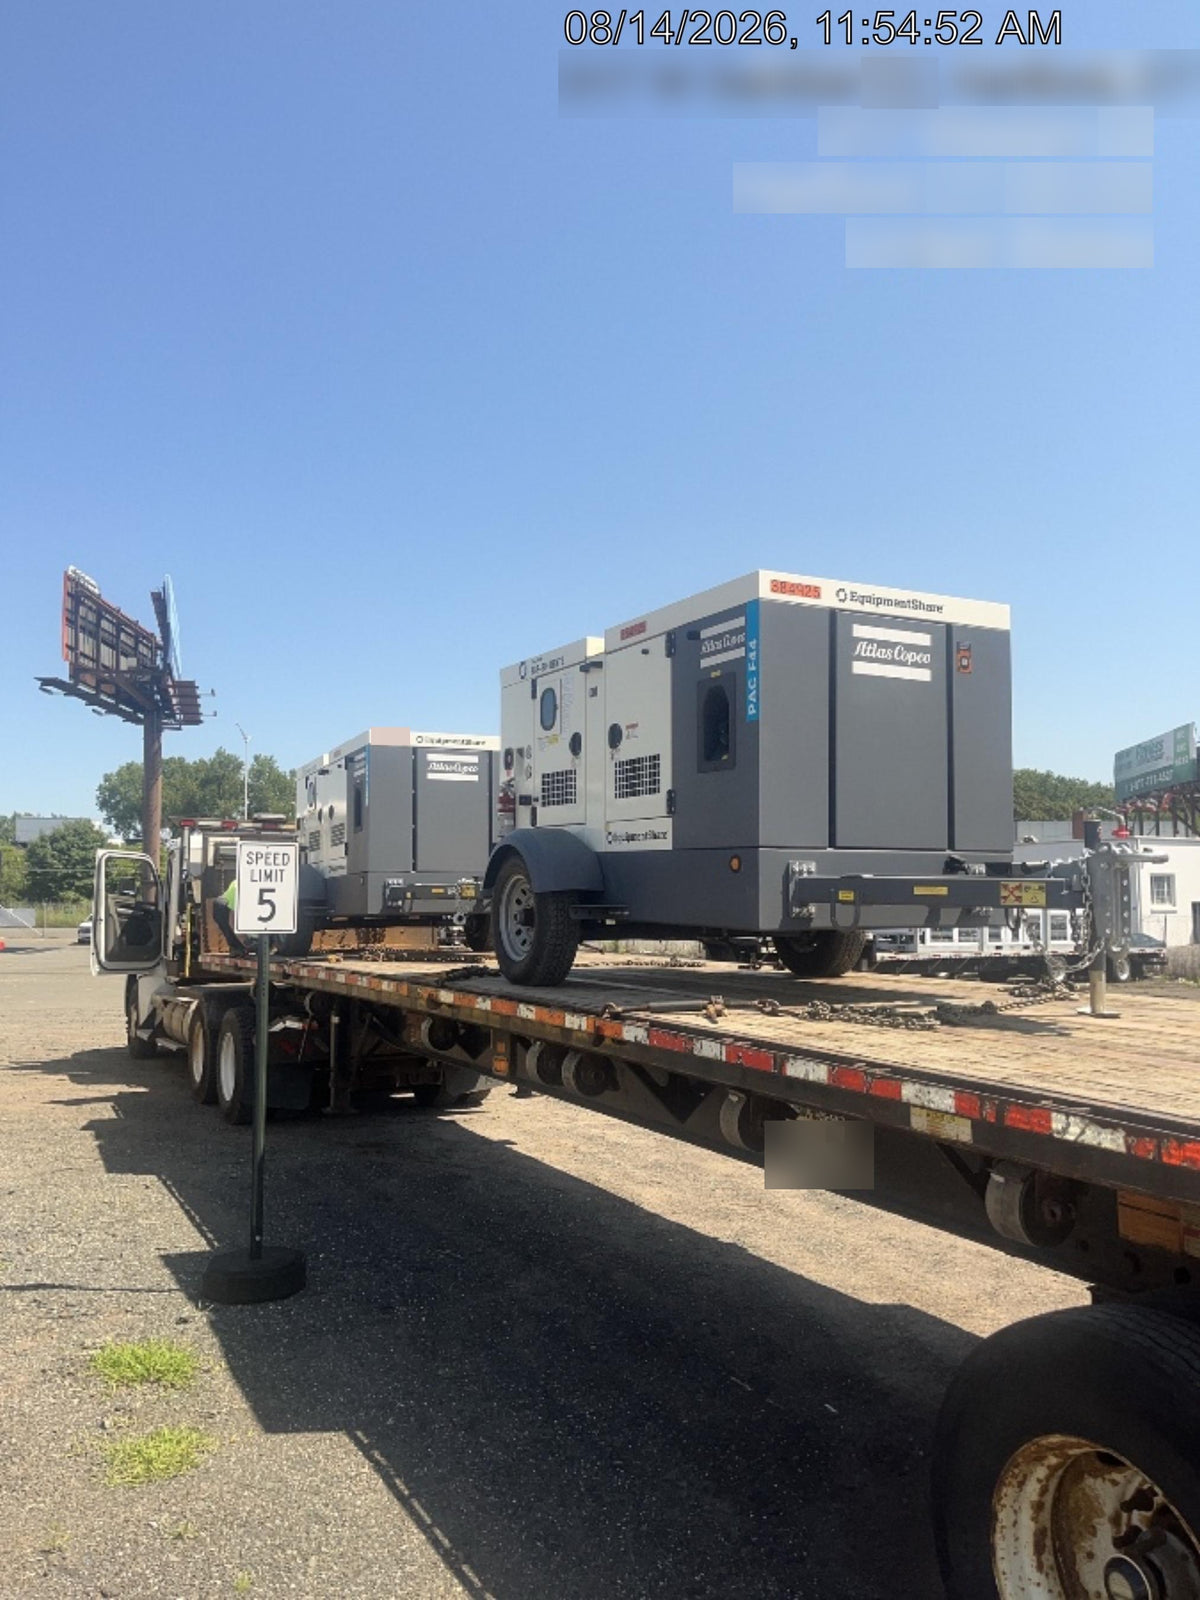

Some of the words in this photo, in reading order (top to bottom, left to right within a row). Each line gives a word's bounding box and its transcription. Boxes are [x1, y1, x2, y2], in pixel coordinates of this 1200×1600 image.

[849, 590, 943, 613] EquipmentShare
[854, 641, 893, 660] Atlas
[894, 645, 931, 665] Copco
[748, 677, 757, 716] PAC
[246, 851, 290, 867] SPEED
[250, 869, 285, 883] LIMIT
[257, 888, 276, 923] 5
